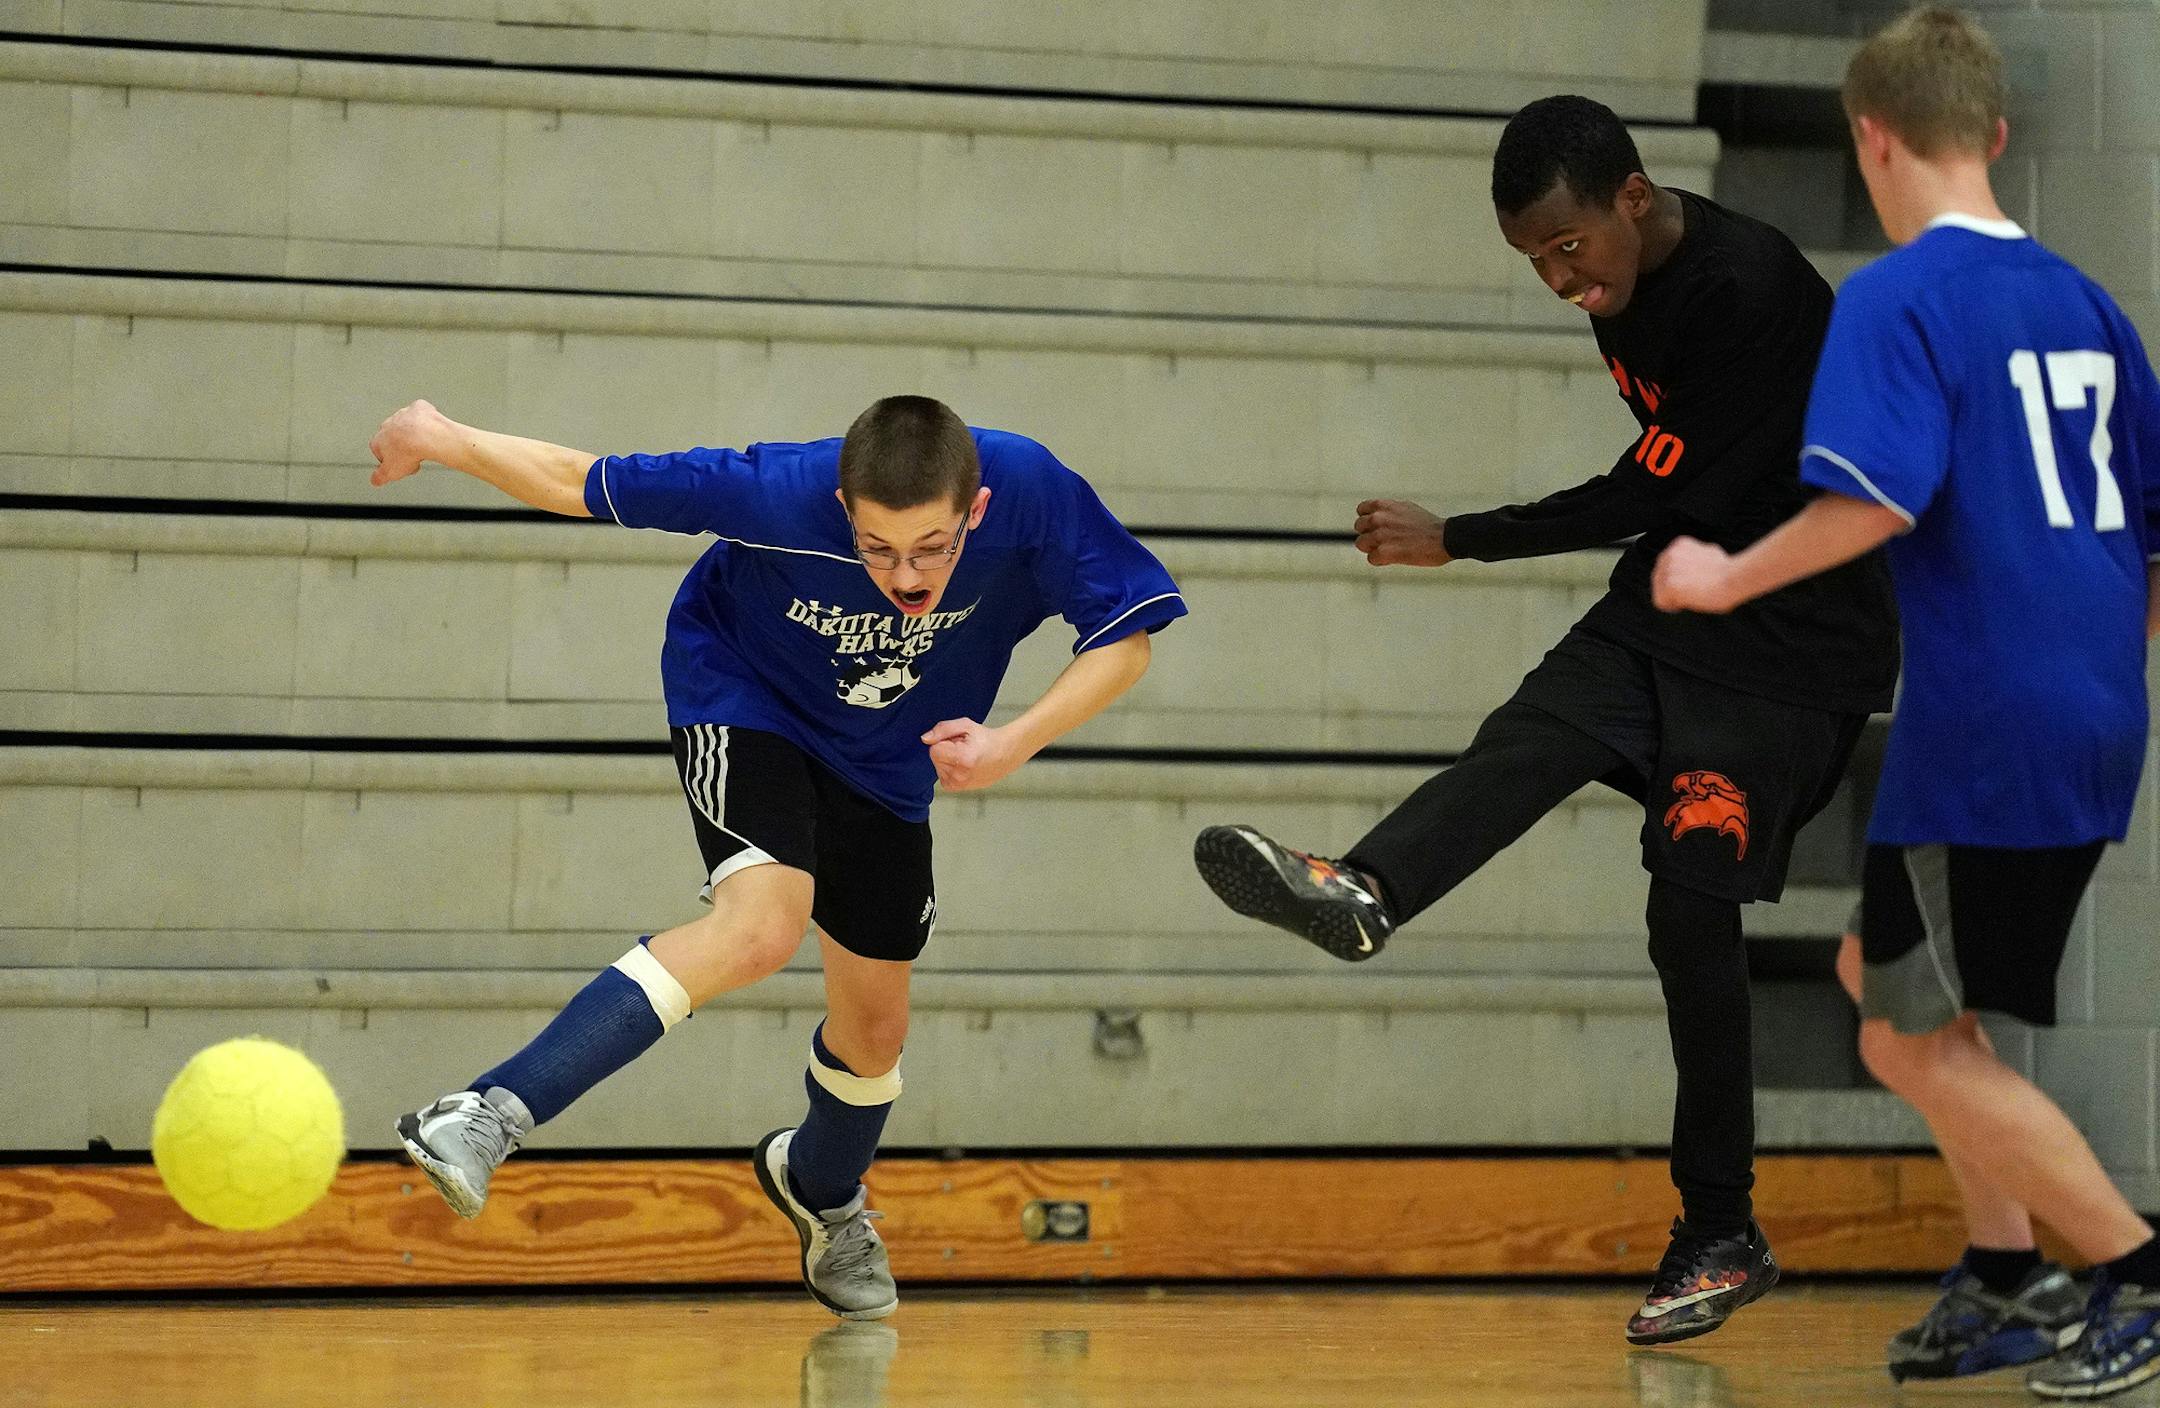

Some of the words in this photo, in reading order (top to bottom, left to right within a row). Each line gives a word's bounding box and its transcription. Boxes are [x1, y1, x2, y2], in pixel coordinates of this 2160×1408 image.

[1634, 425, 1685, 477] 10
[2007, 349, 2126, 531] 17
[785, 597, 894, 636] DAKOTA
[835, 631, 934, 657] HAWKS
